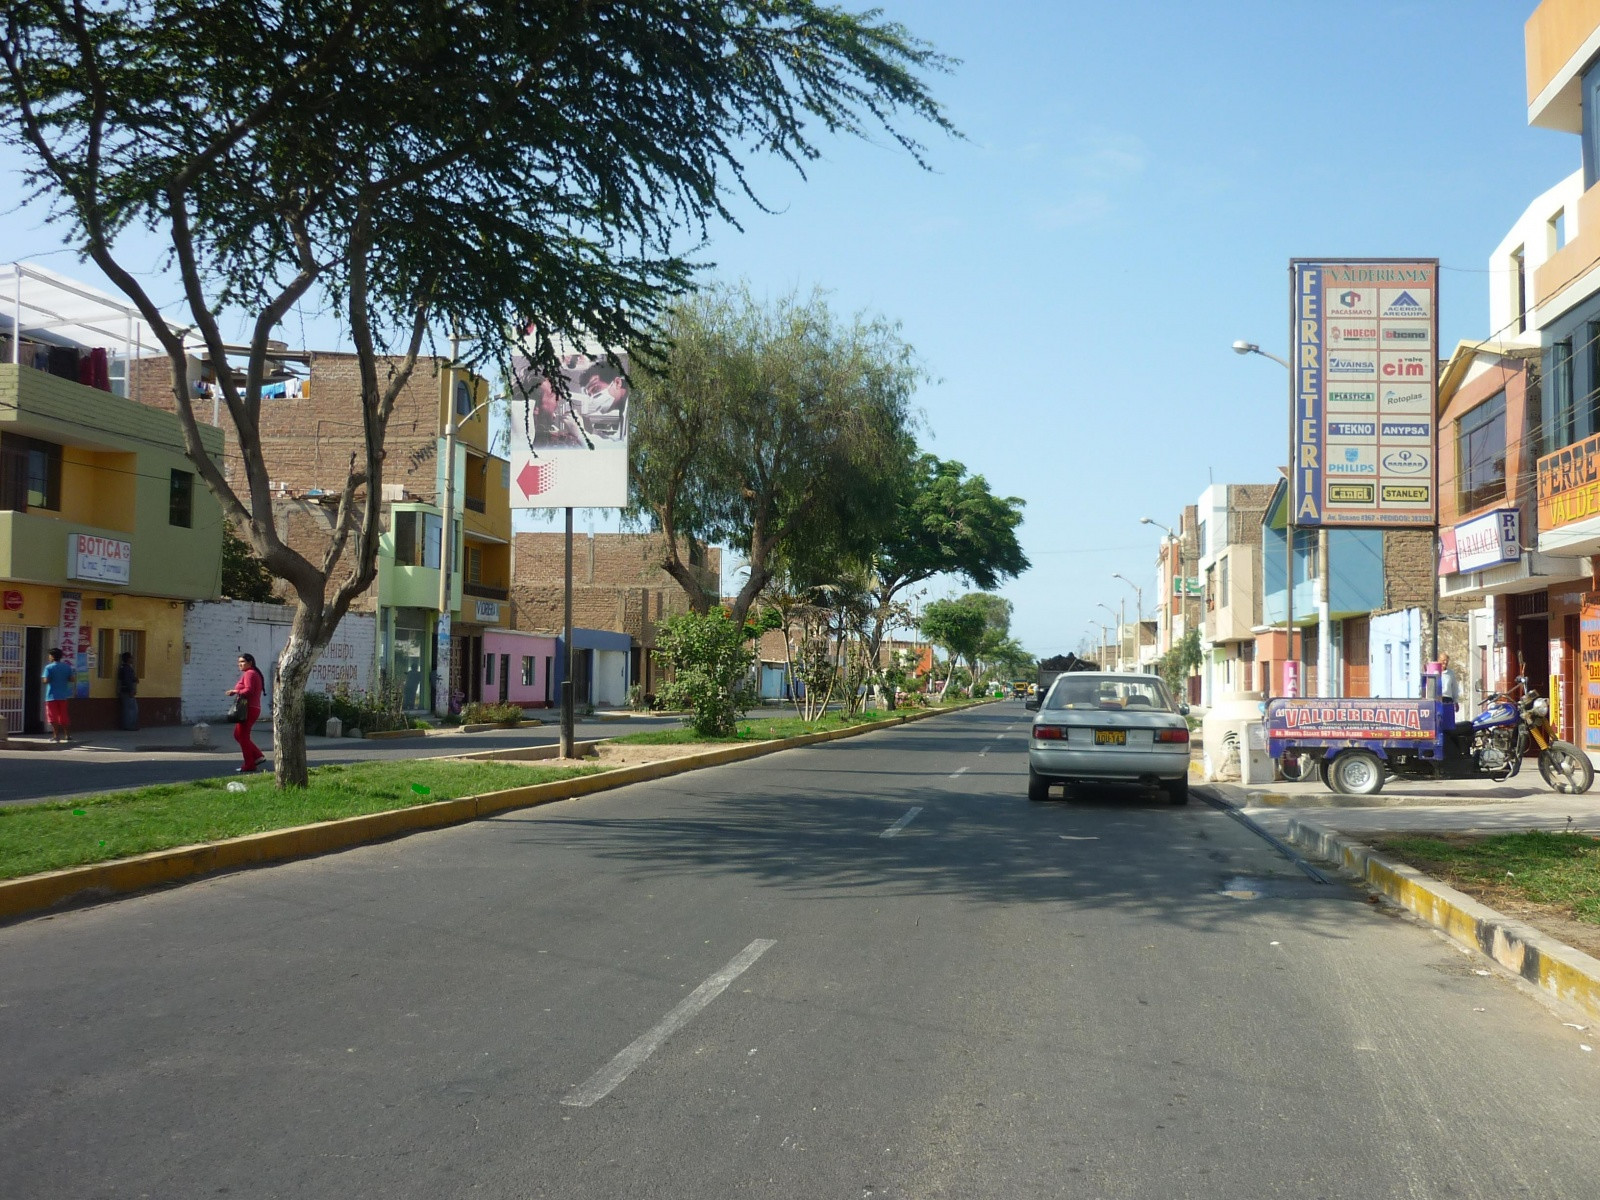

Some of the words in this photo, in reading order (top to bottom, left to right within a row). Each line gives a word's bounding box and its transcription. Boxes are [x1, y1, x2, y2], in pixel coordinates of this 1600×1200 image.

[1343, 329, 1376, 337] INDECO
[1382, 358, 1424, 376] cim
[1299, 271, 1319, 518] FERRETERIA
[1387, 393, 1423, 405] Rotoplas
[1338, 424, 1372, 434] TEKNO
[1383, 426, 1425, 435] ANYPSA
[1328, 464, 1375, 472] PHILIPS
[1539, 437, 1600, 498] FERRE
[1386, 490, 1424, 498] STANLEY
[79, 535, 121, 559] BOTICA
[312, 664, 358, 680] PROPAGANDA
